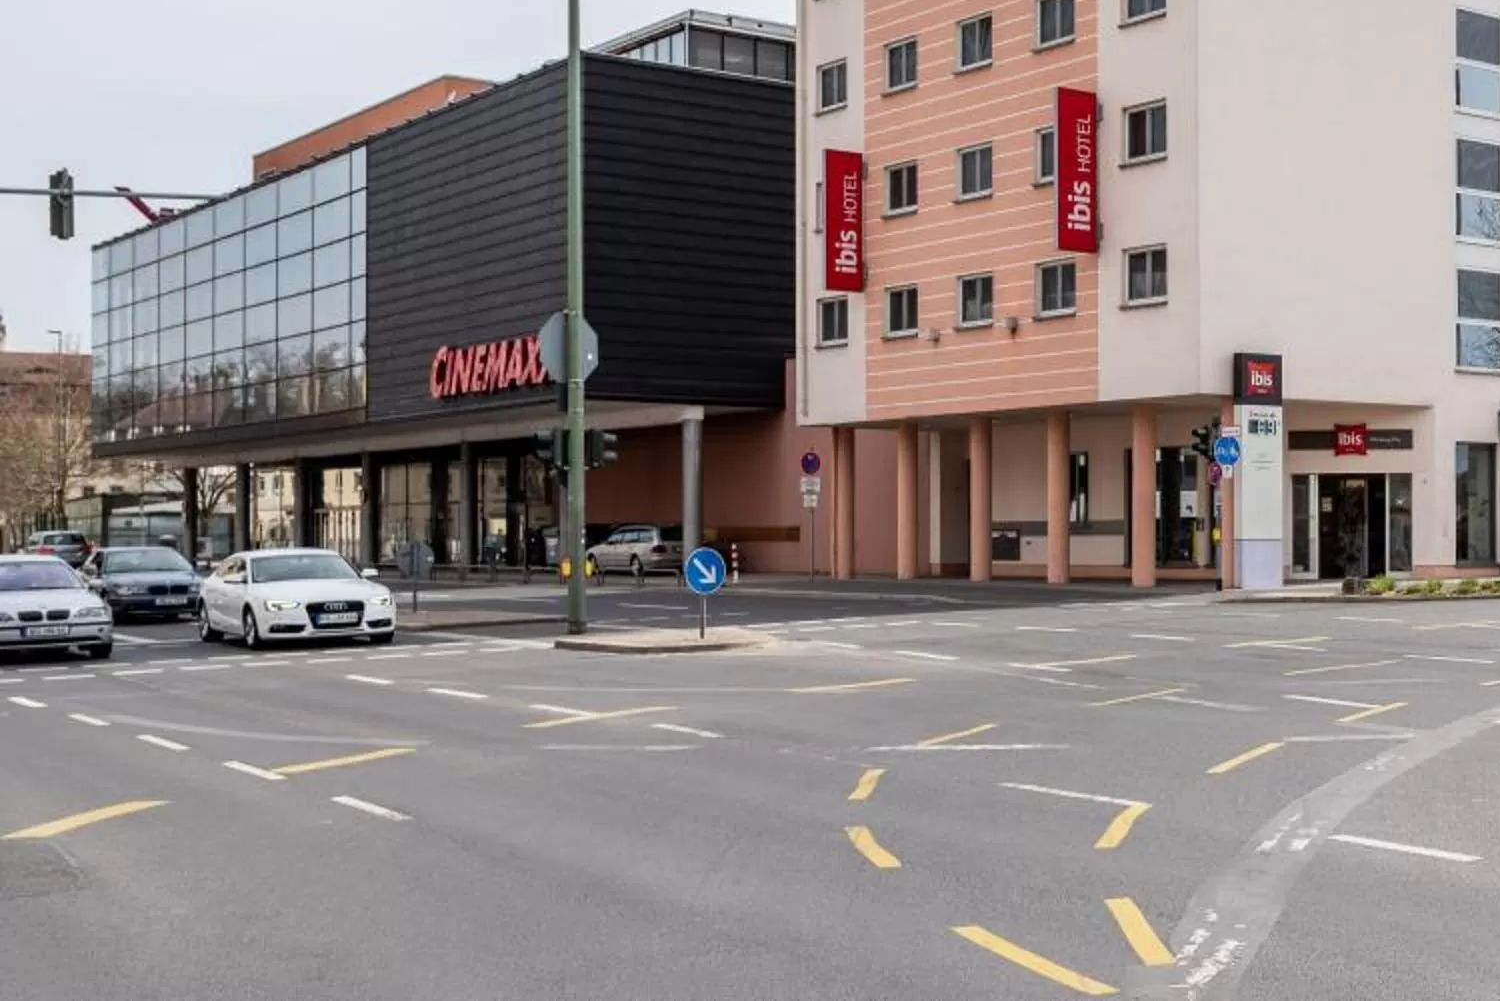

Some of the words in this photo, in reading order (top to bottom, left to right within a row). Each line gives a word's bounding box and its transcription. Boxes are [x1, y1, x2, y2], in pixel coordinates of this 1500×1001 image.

[1075, 114, 1091, 173] HOTEL
[843, 171, 857, 223] HOTEL
[1067, 181, 1091, 232] ibis
[835, 230, 857, 274] ibis
[430, 335, 549, 398] CINEMAX
[1250, 370, 1273, 386] ibis
[1337, 431, 1363, 447] ibis
